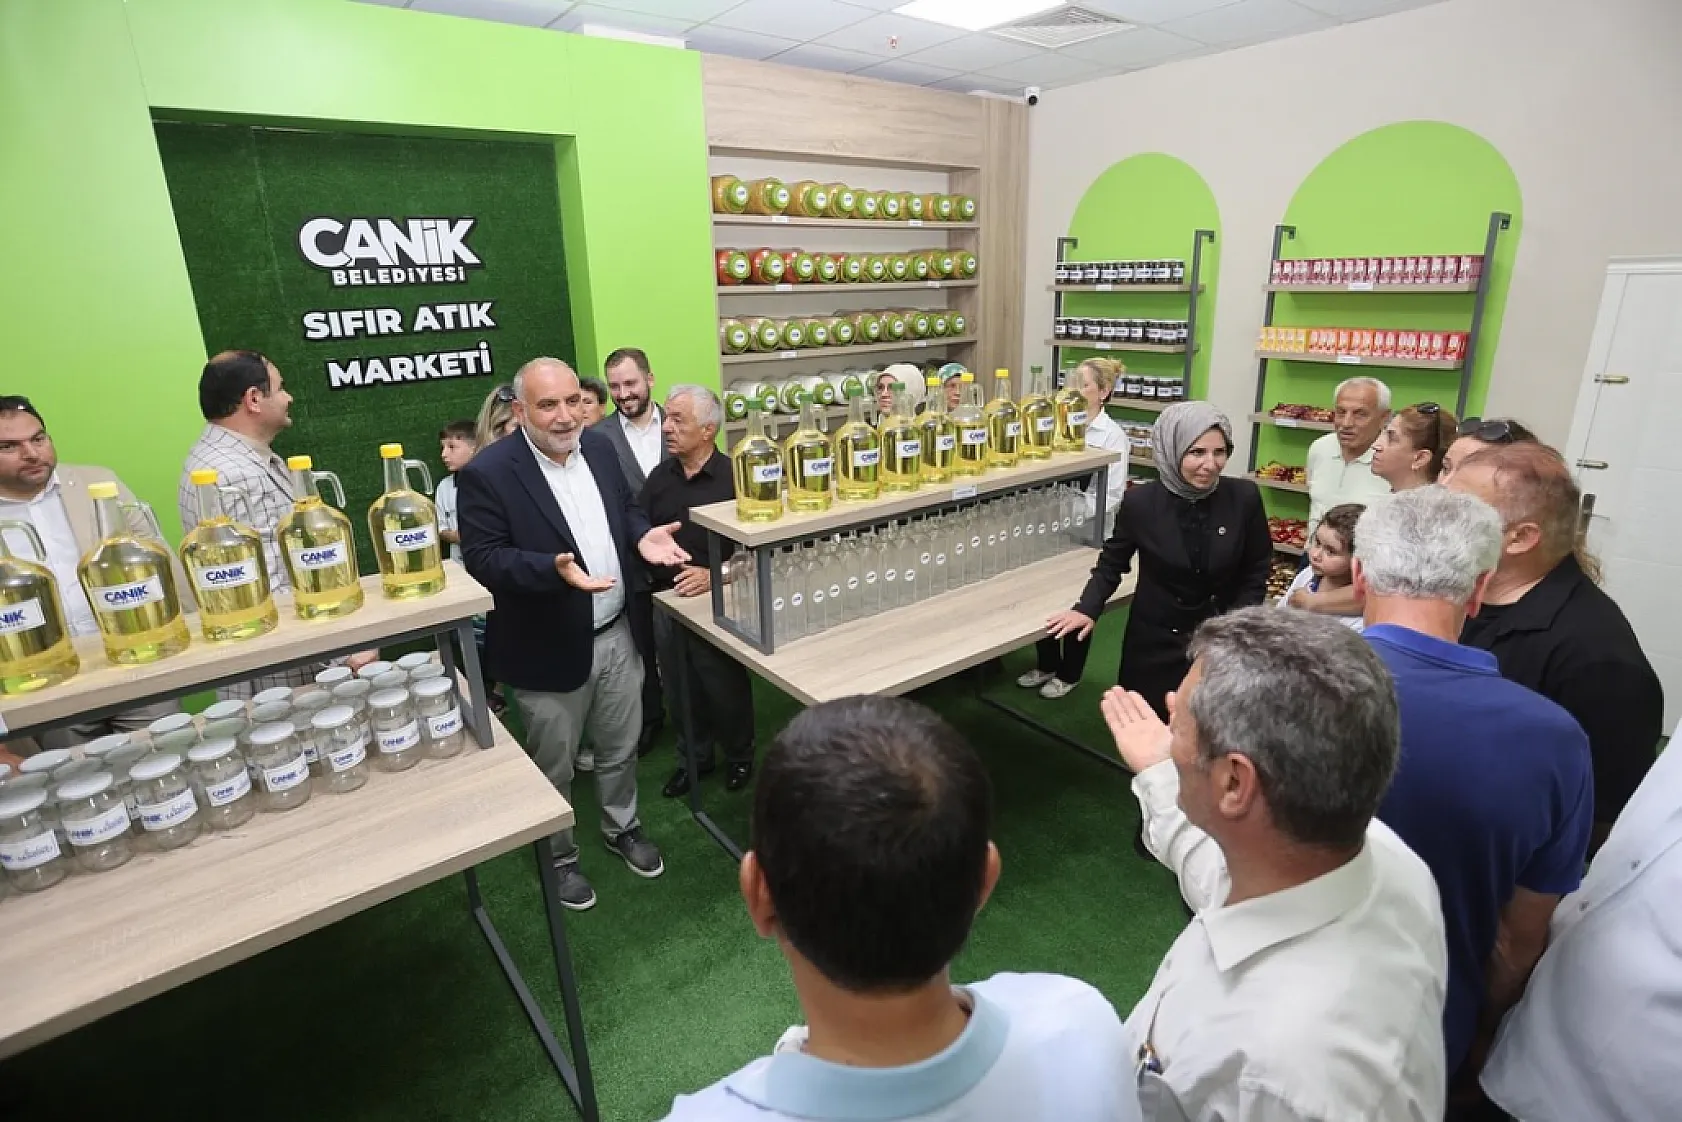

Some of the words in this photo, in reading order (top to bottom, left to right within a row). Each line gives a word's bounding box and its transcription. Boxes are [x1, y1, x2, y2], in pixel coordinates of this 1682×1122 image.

[303, 308, 404, 338] SIFIR
[413, 302, 496, 331] ATIK
[327, 341, 492, 388] MARKETİ
